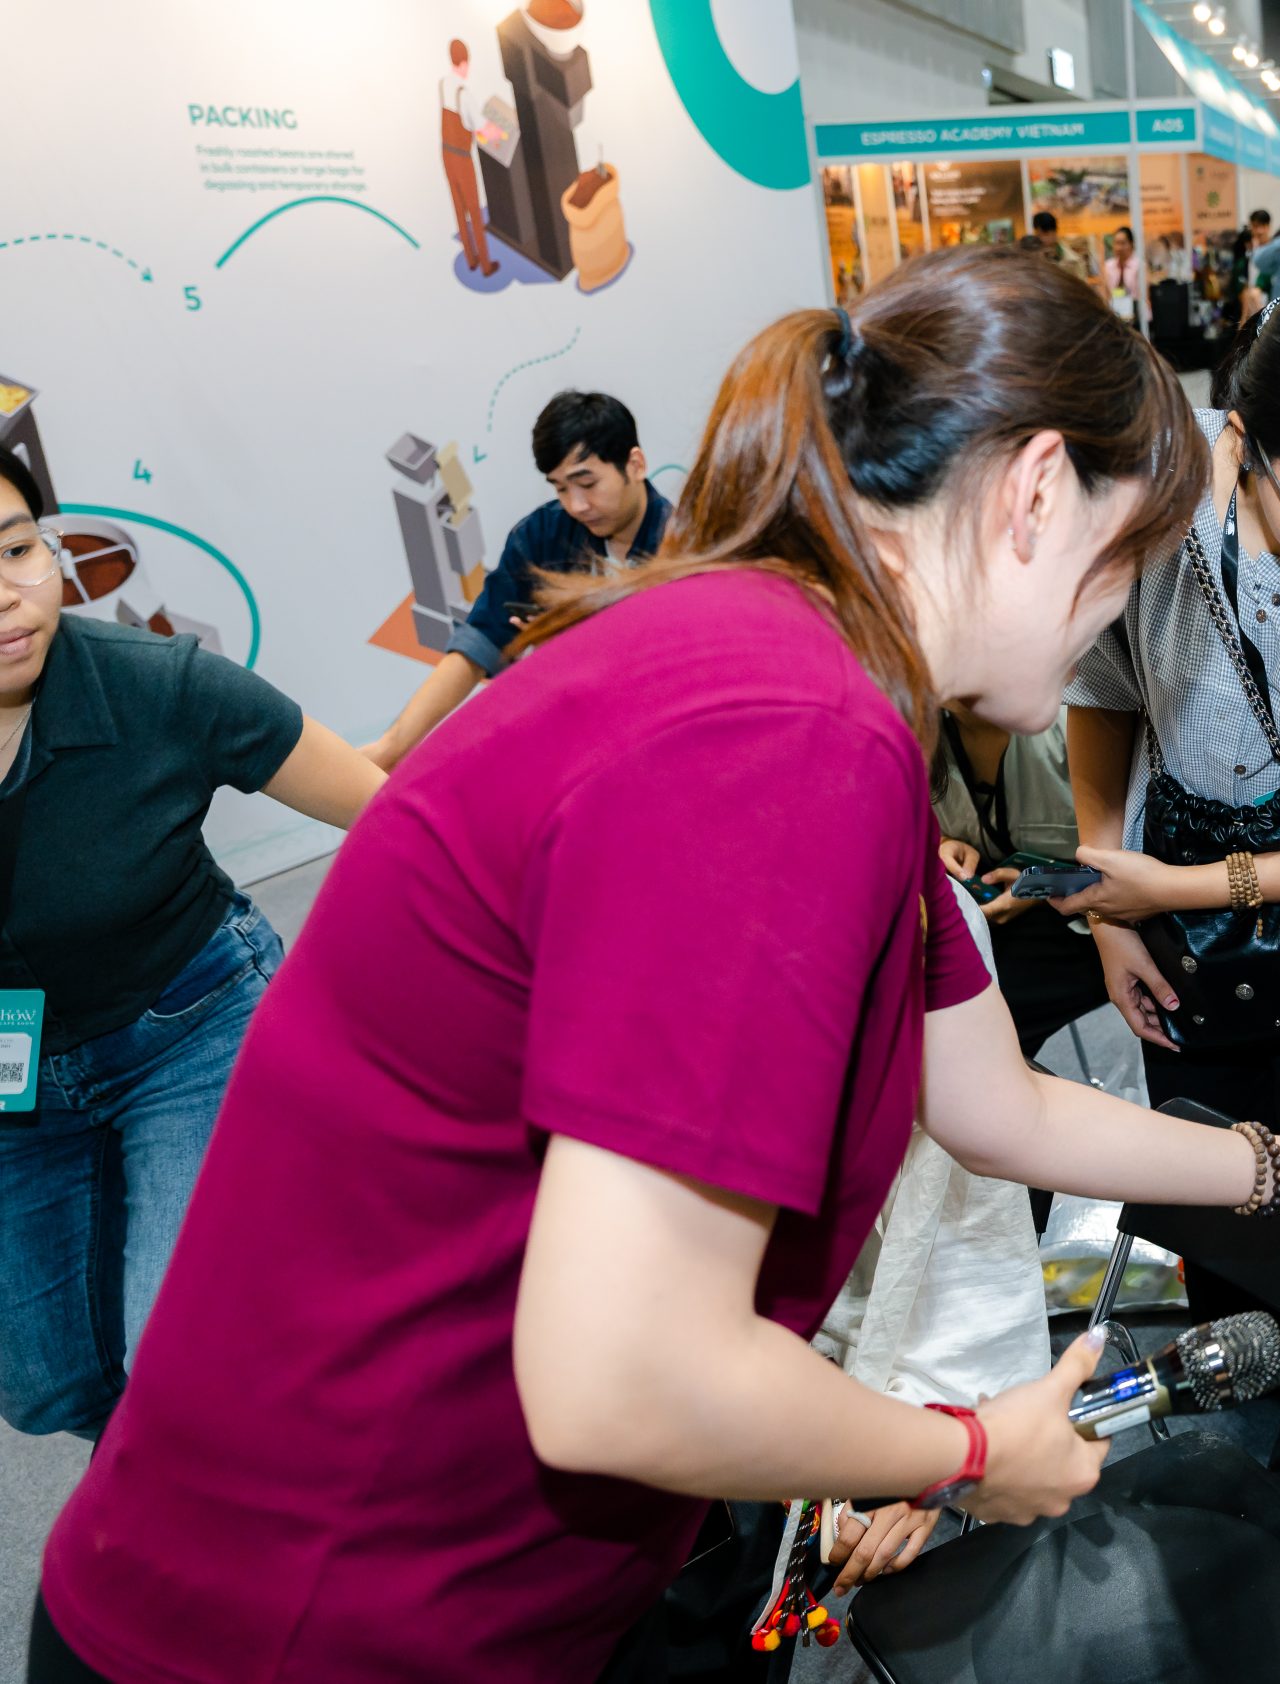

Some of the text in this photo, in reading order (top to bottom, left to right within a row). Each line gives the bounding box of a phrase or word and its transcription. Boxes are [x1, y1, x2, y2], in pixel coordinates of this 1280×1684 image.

[188, 103, 298, 130] PACKING
[861, 122, 1085, 146] ESPRESSO ACADEMY VIETNAM
[183, 286, 202, 311] 5
[132, 459, 153, 484] 4
